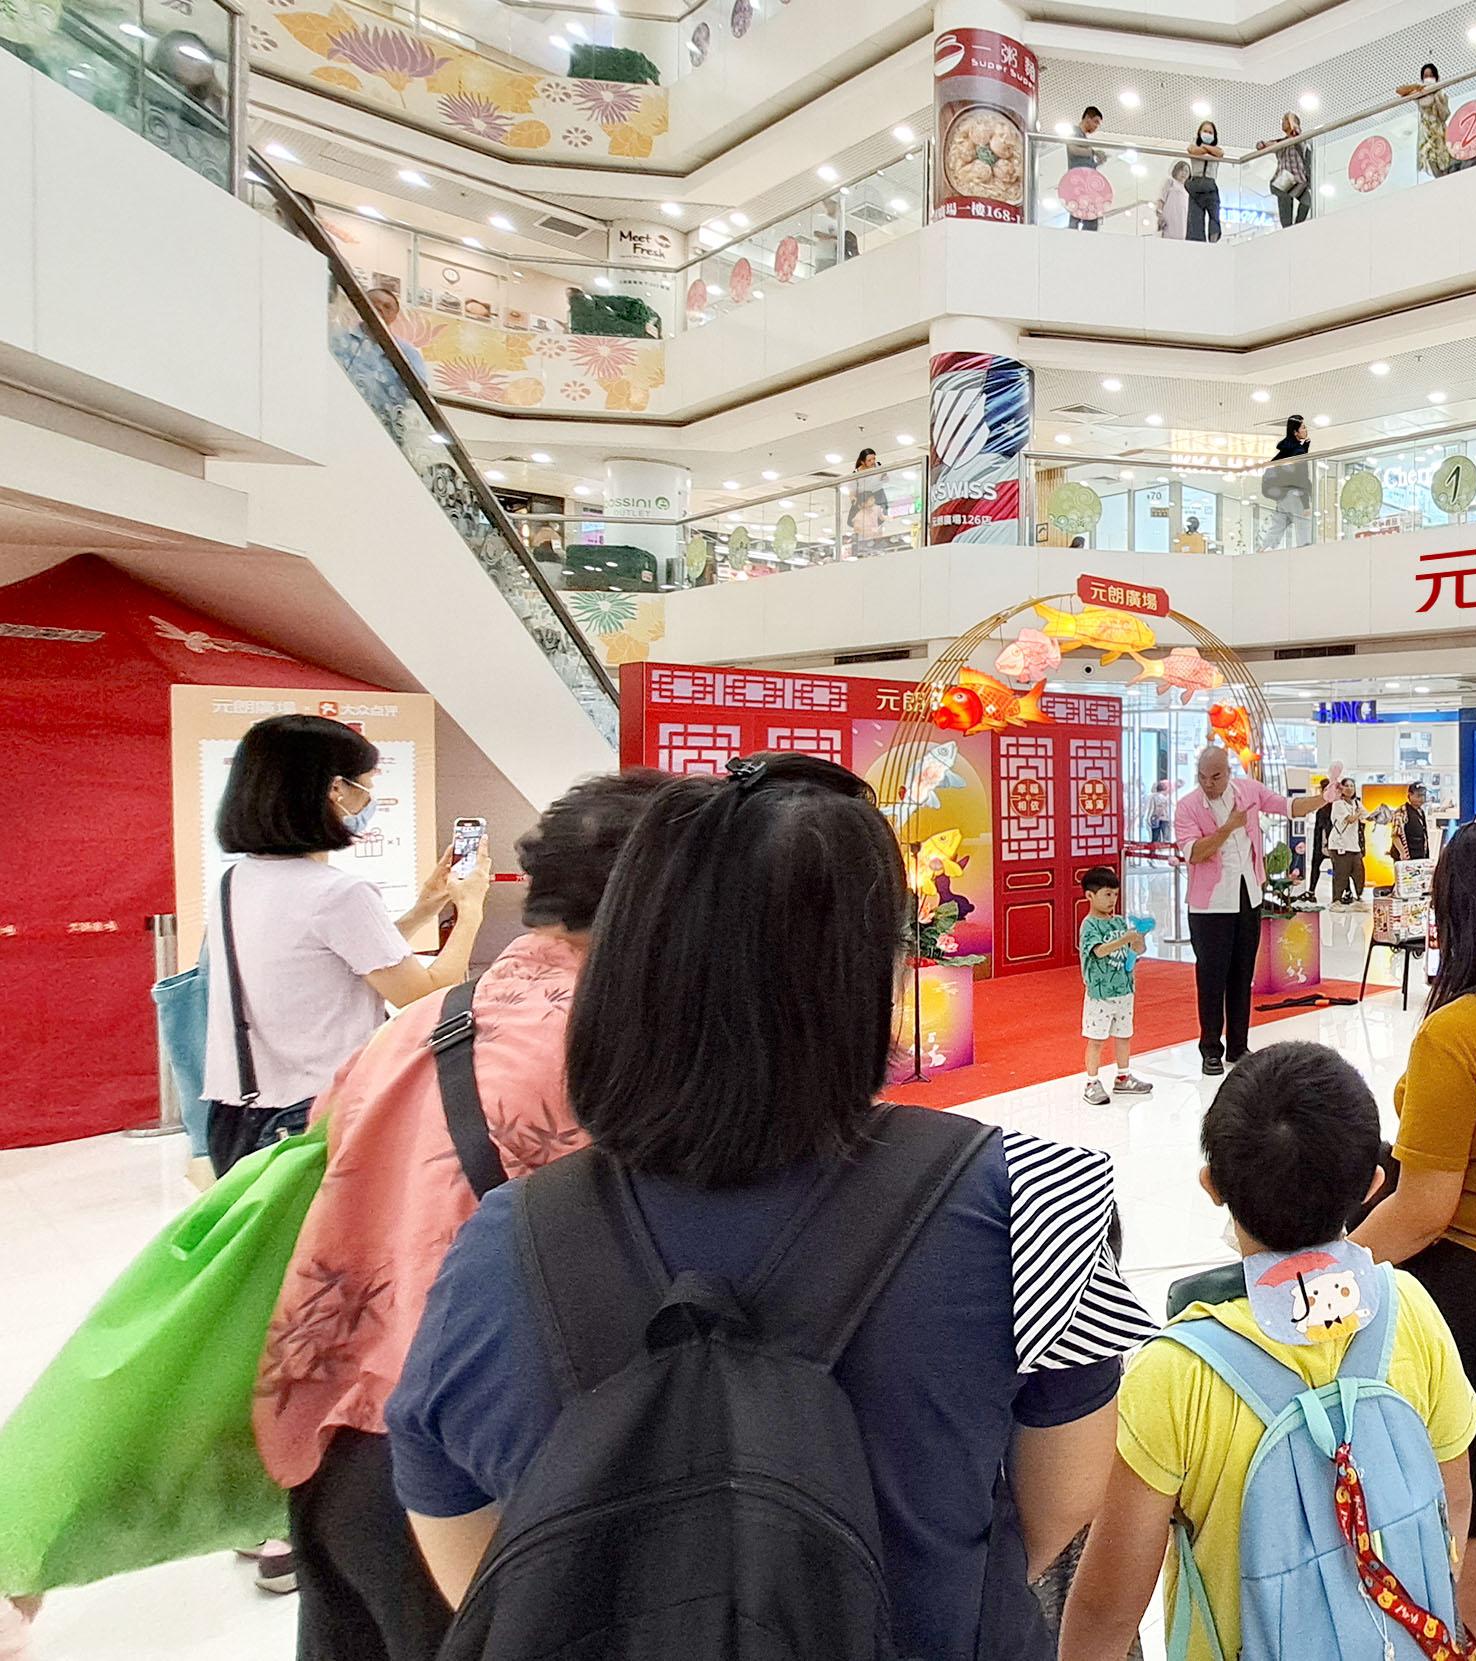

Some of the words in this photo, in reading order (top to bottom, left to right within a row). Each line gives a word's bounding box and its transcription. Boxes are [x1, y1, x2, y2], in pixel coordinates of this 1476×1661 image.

[619, 230, 652, 243] Meet
[633, 243, 666, 259] Fresh
[1089, 580, 1158, 612] 元朗廣場
